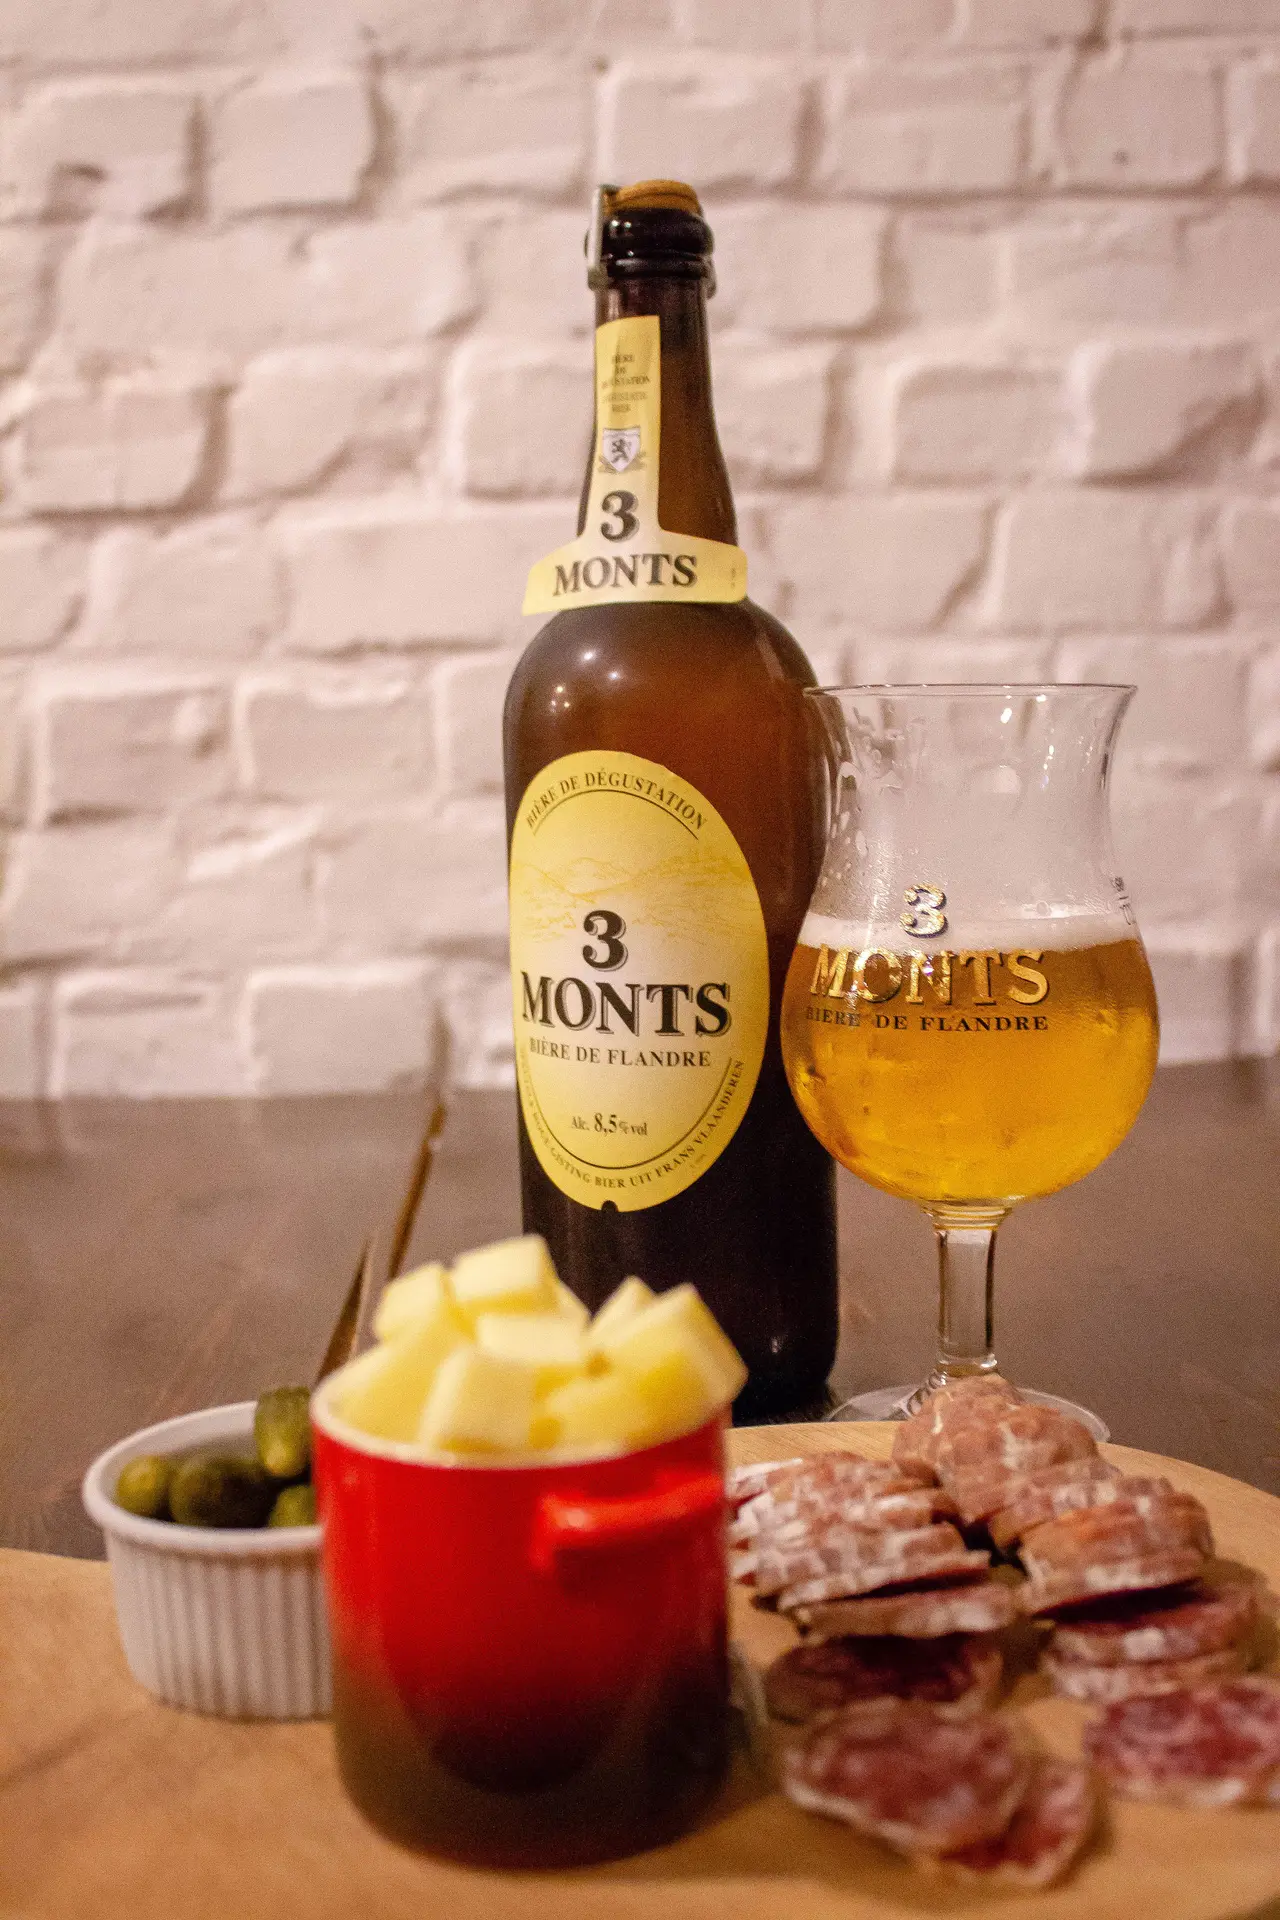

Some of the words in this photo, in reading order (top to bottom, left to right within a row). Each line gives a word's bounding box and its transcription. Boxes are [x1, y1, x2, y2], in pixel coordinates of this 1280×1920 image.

[601, 490, 640, 543] 3
[552, 553, 698, 597] MONTS
[526, 788, 557, 829] BIÈRE
[560, 775, 581, 796] DE
[585, 768, 707, 830] DÉGUSTATION
[582, 909, 629, 972] 3
[900, 882, 949, 940] 3
[521, 971, 732, 1038] MONTS
[810, 943, 1051, 1006] MONTS
[529, 1036, 571, 1061] BIÈRE
[576, 1046, 601, 1064] DE
[608, 1049, 711, 1068] FLANDRE
[874, 1014, 908, 1030] DE
[920, 1015, 1050, 1032] FLANDRE
[594, 1175, 627, 1189] BIER
[629, 1172, 653, 1187] UIT
[656, 1144, 696, 1178] FRANS
[693, 1059, 745, 1145] VLAANDEREN
